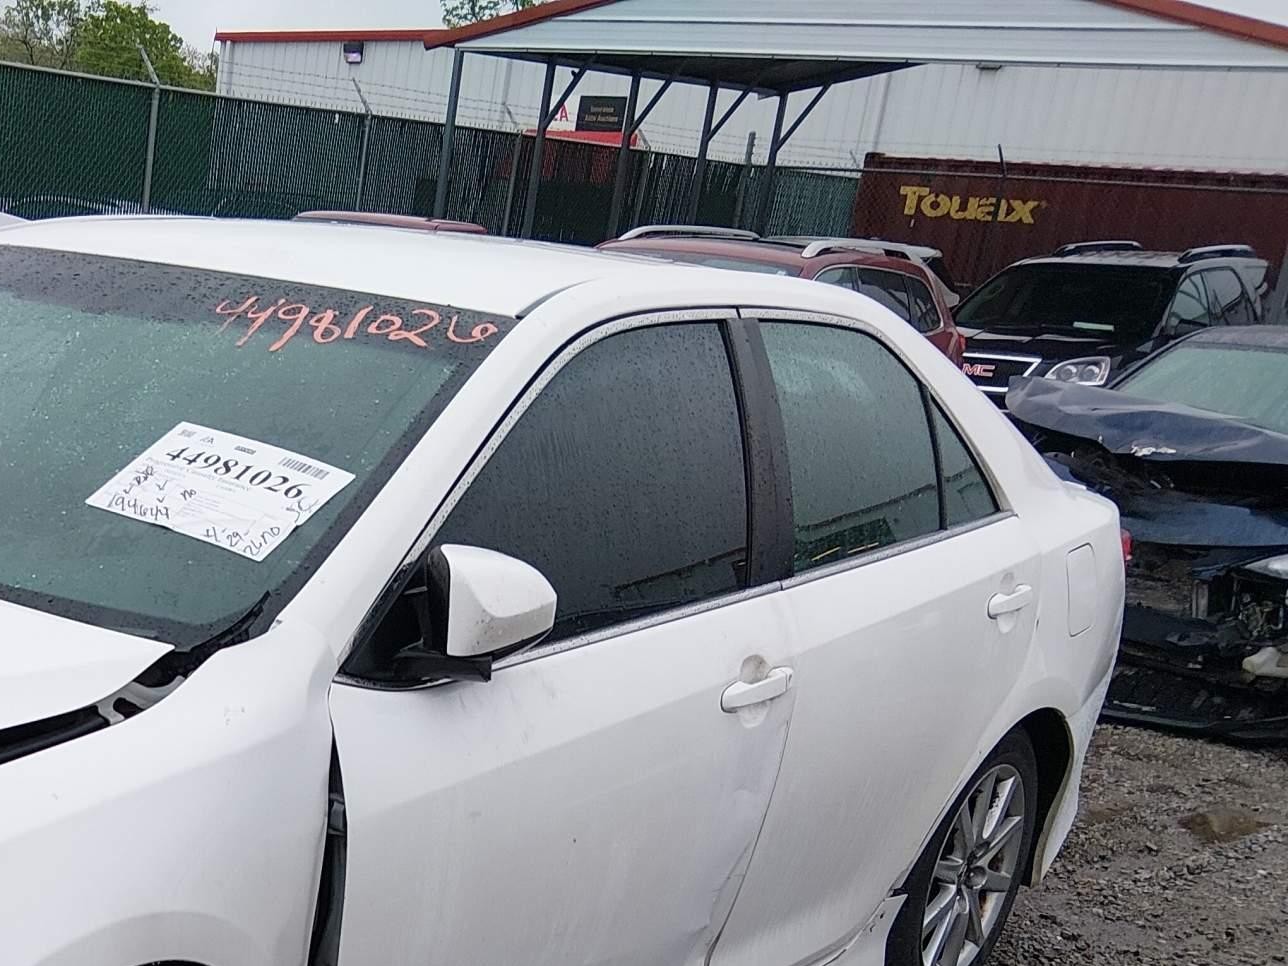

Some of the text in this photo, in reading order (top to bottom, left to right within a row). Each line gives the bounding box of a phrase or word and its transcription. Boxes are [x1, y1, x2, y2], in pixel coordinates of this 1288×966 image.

[215, 295, 499, 352] 44981026
[961, 363, 996, 377] MC
[165, 446, 312, 500] 44981026
